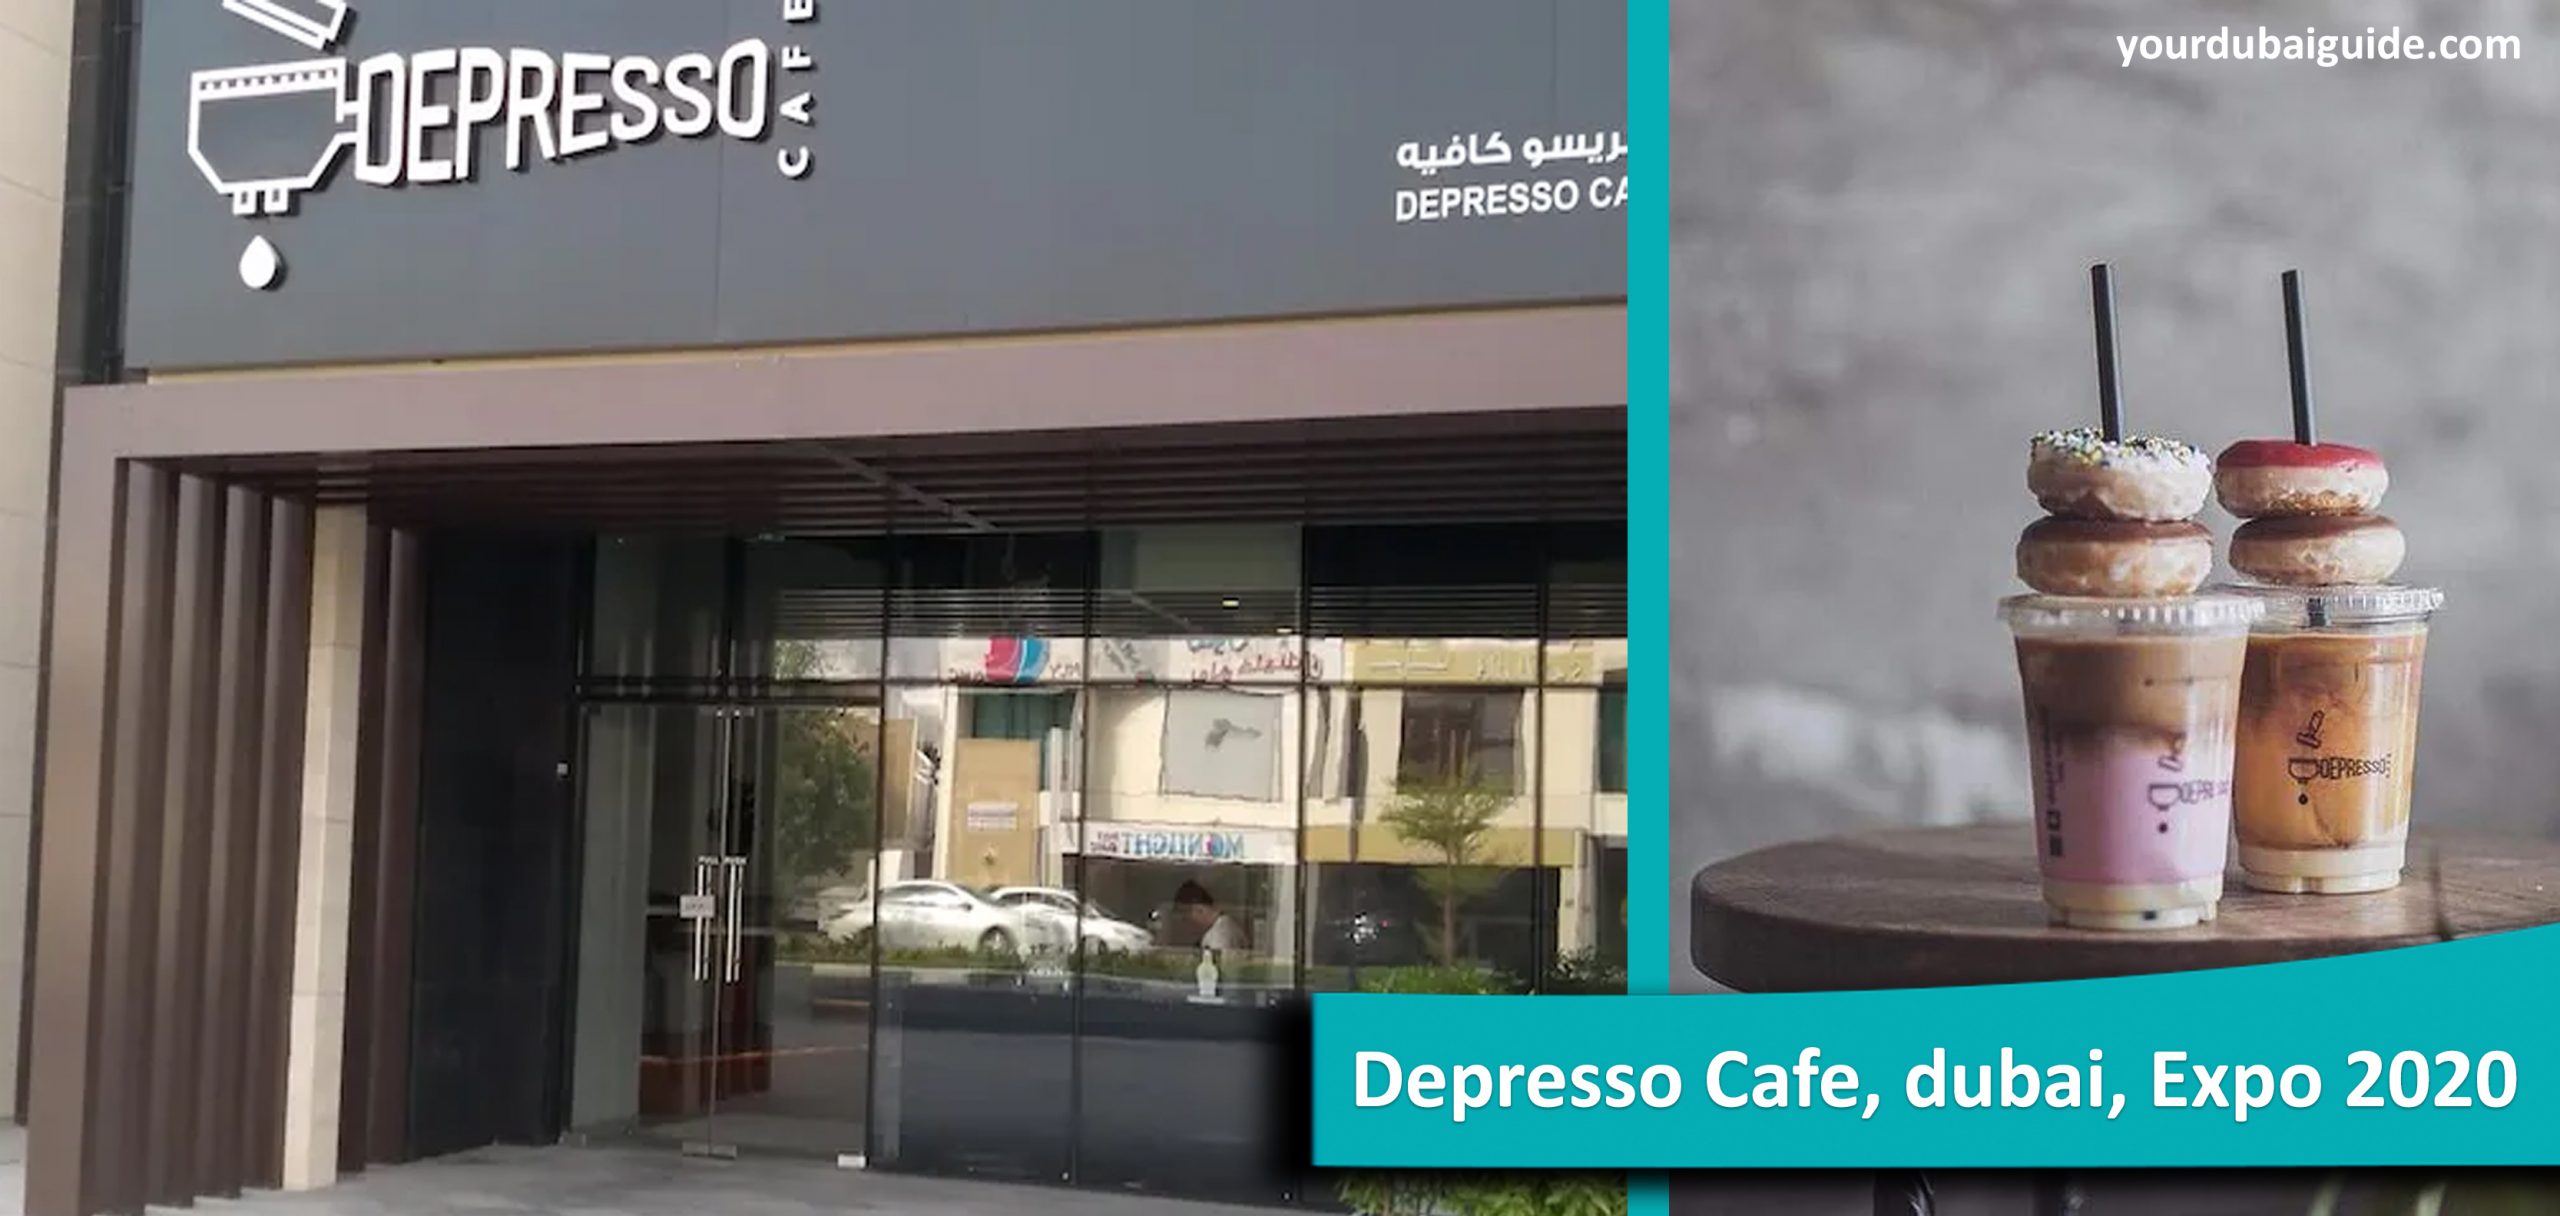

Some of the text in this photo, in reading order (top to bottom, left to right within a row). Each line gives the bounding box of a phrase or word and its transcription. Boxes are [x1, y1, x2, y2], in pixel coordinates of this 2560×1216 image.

[778, 0, 814, 178] CAFE
[355, 38, 768, 185] DEPRESSO
[1396, 131, 1512, 175] كافيه
[1396, 179, 1580, 221] DEPRESSO
[2320, 757, 2386, 779] DEPRESSO
